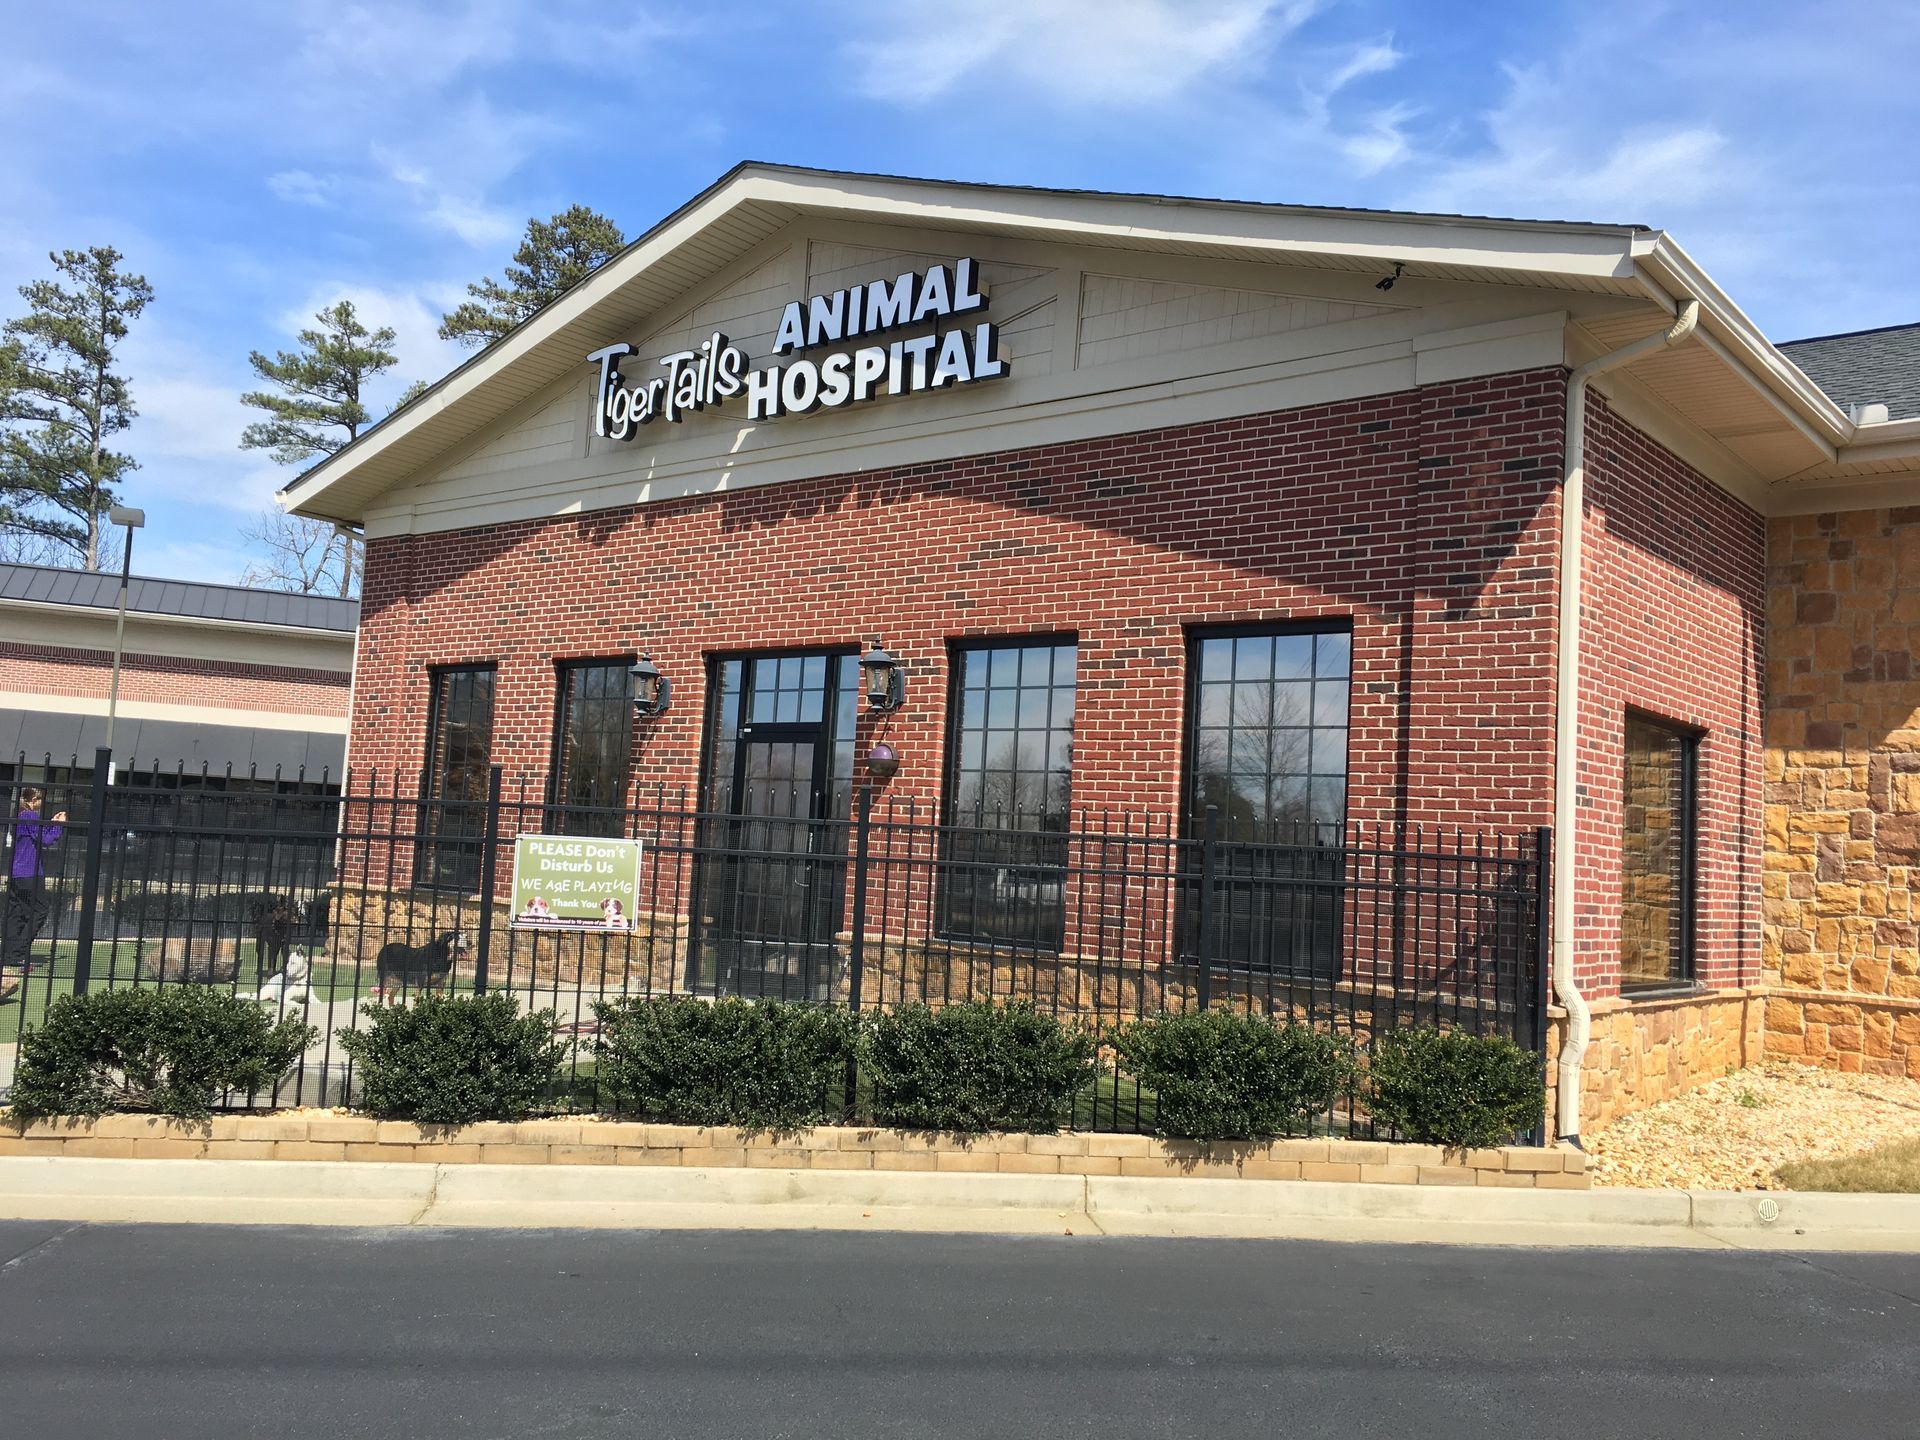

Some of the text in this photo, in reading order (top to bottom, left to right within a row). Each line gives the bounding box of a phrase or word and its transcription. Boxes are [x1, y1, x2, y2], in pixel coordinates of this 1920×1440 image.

[772, 257, 986, 355] ANIMAL
[747, 322, 1003, 420] HOSPITAL
[586, 331, 743, 440] Tiger Tails
[529, 842, 626, 858] PLEASE Don't
[540, 859, 614, 874] Disturb Us
[521, 878, 542, 890] WE
[552, 898, 598, 908] Thank You
